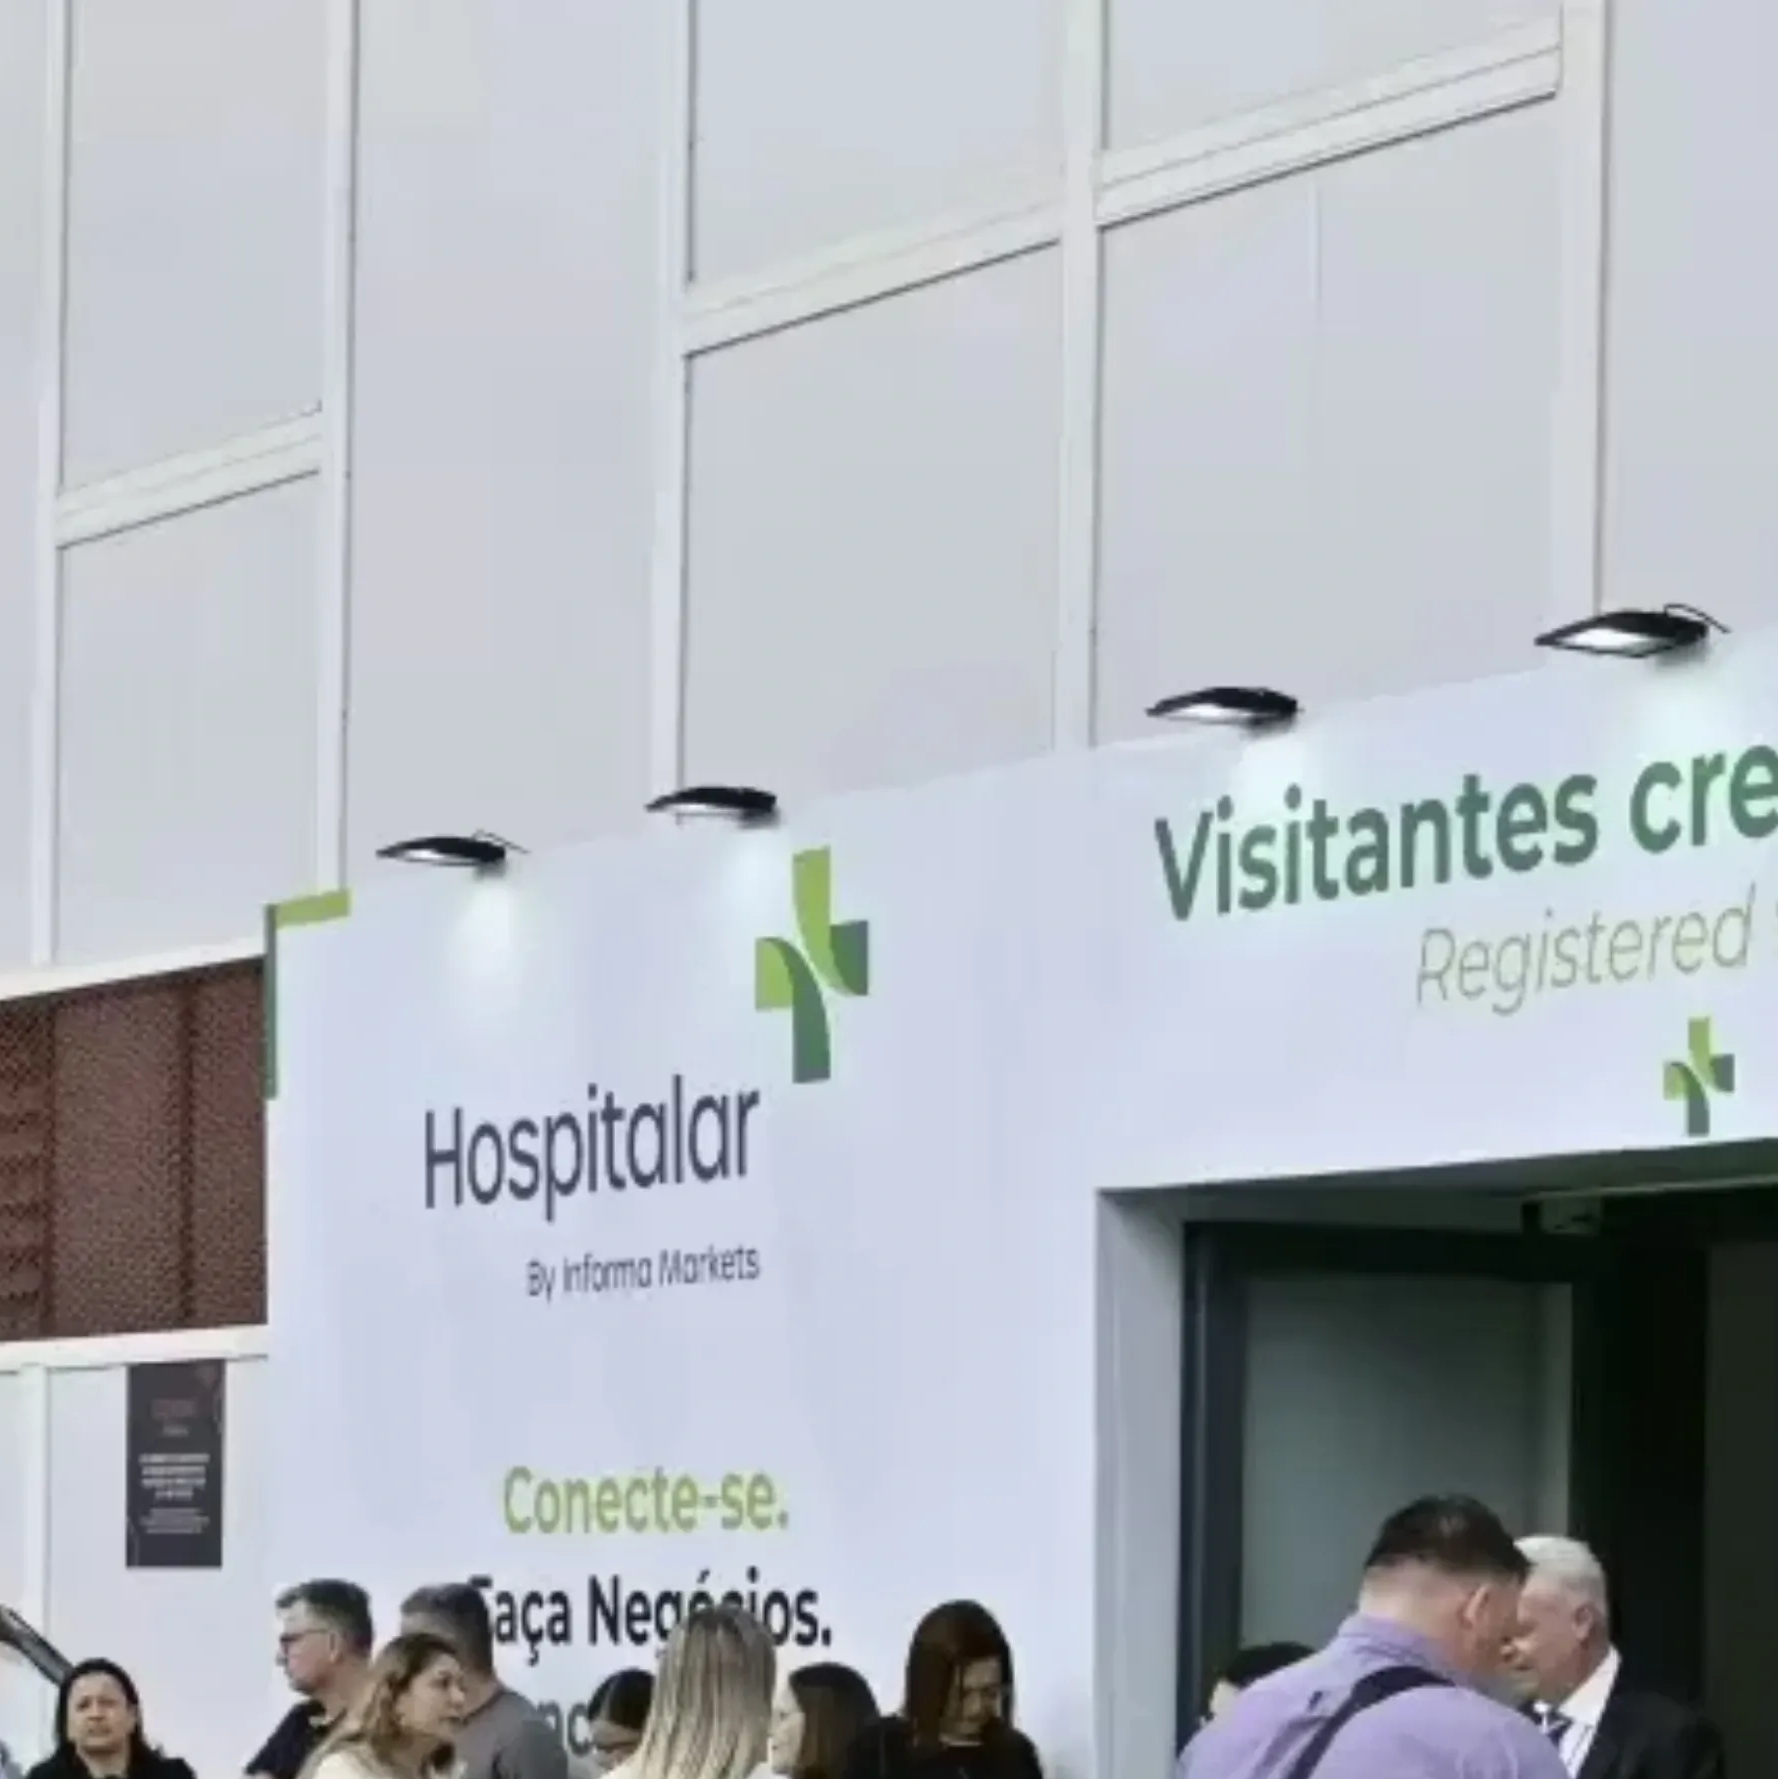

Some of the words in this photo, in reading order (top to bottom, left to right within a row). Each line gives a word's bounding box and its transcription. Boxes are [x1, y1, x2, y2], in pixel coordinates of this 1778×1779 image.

[1155, 774, 1599, 921] Visitantes
[1417, 882, 1757, 1015] Registered
[425, 1073, 760, 1223] Hospitalar
[527, 1259, 556, 1302] By
[563, 1252, 653, 1293] Informa
[659, 1246, 760, 1286] Markets
[503, 1465, 789, 1534] Conecte-se.
[468, 1574, 573, 1667] aça
[588, 1566, 832, 1655] Negios.
